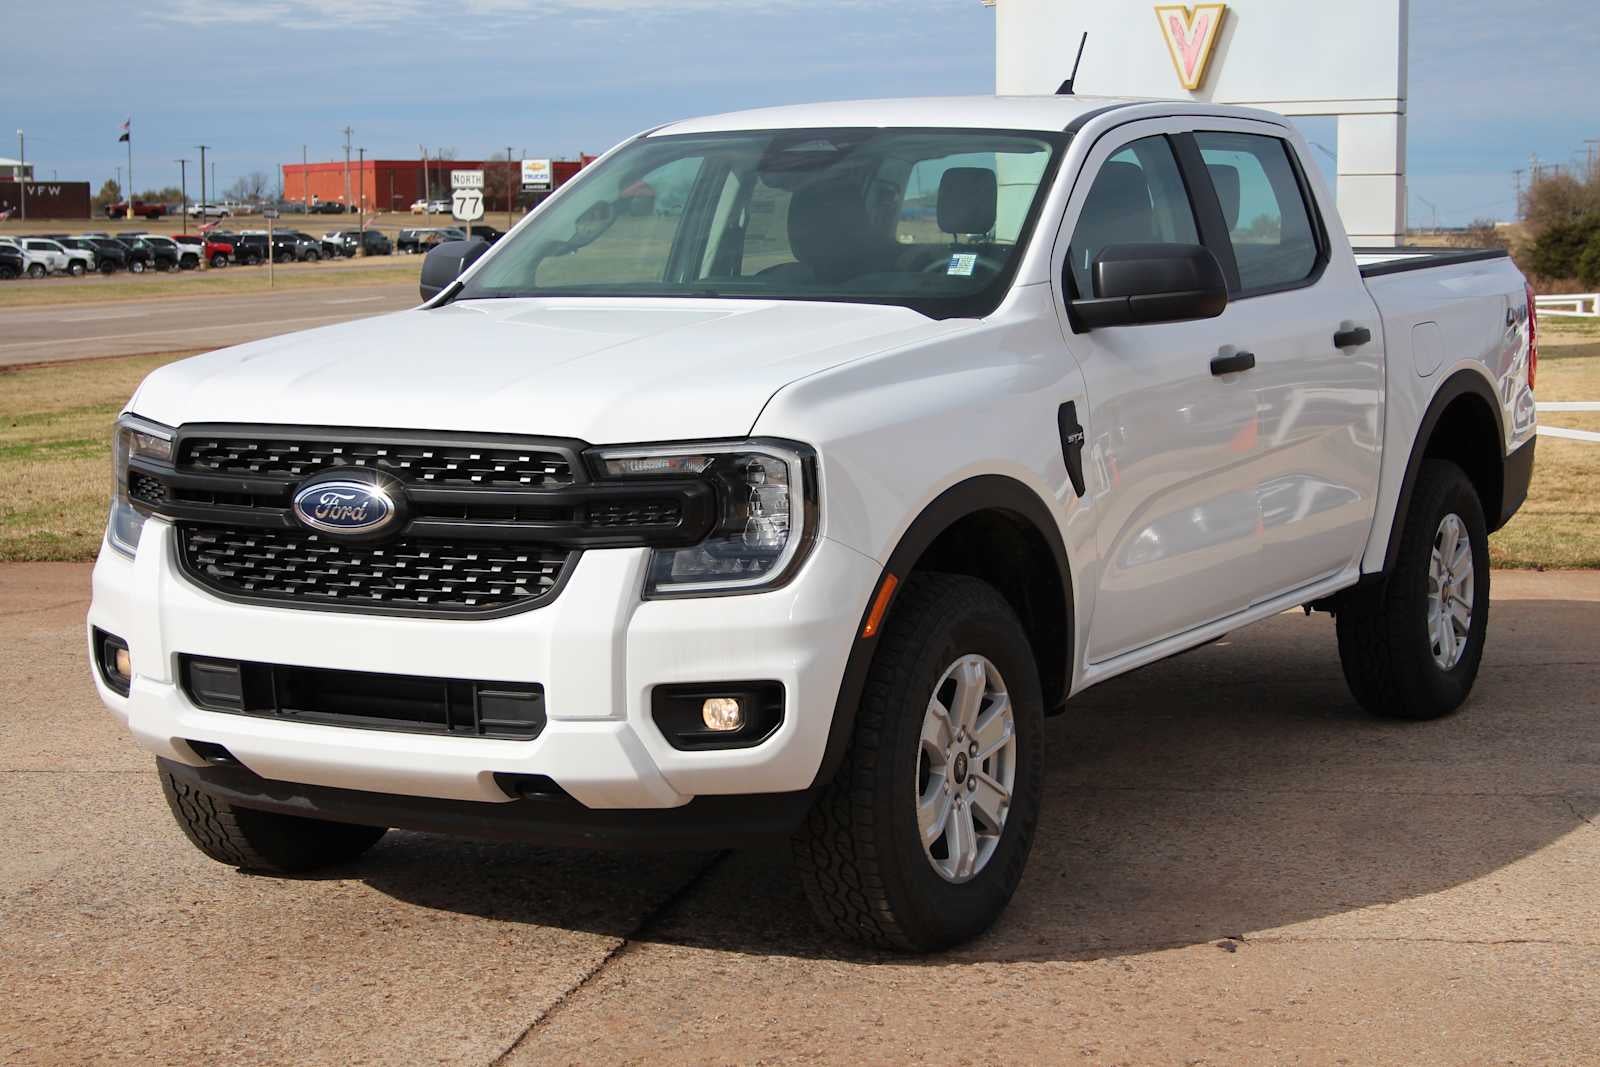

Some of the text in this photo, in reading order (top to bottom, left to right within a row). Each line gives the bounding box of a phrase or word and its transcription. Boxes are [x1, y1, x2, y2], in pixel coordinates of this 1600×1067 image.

[1154, 4, 1226, 90] V
[453, 174, 481, 185] NORTH
[27, 185, 61, 197] VFW
[455, 196, 480, 215] 77
[1068, 431, 1083, 443] STX
[315, 492, 369, 521] Ford
